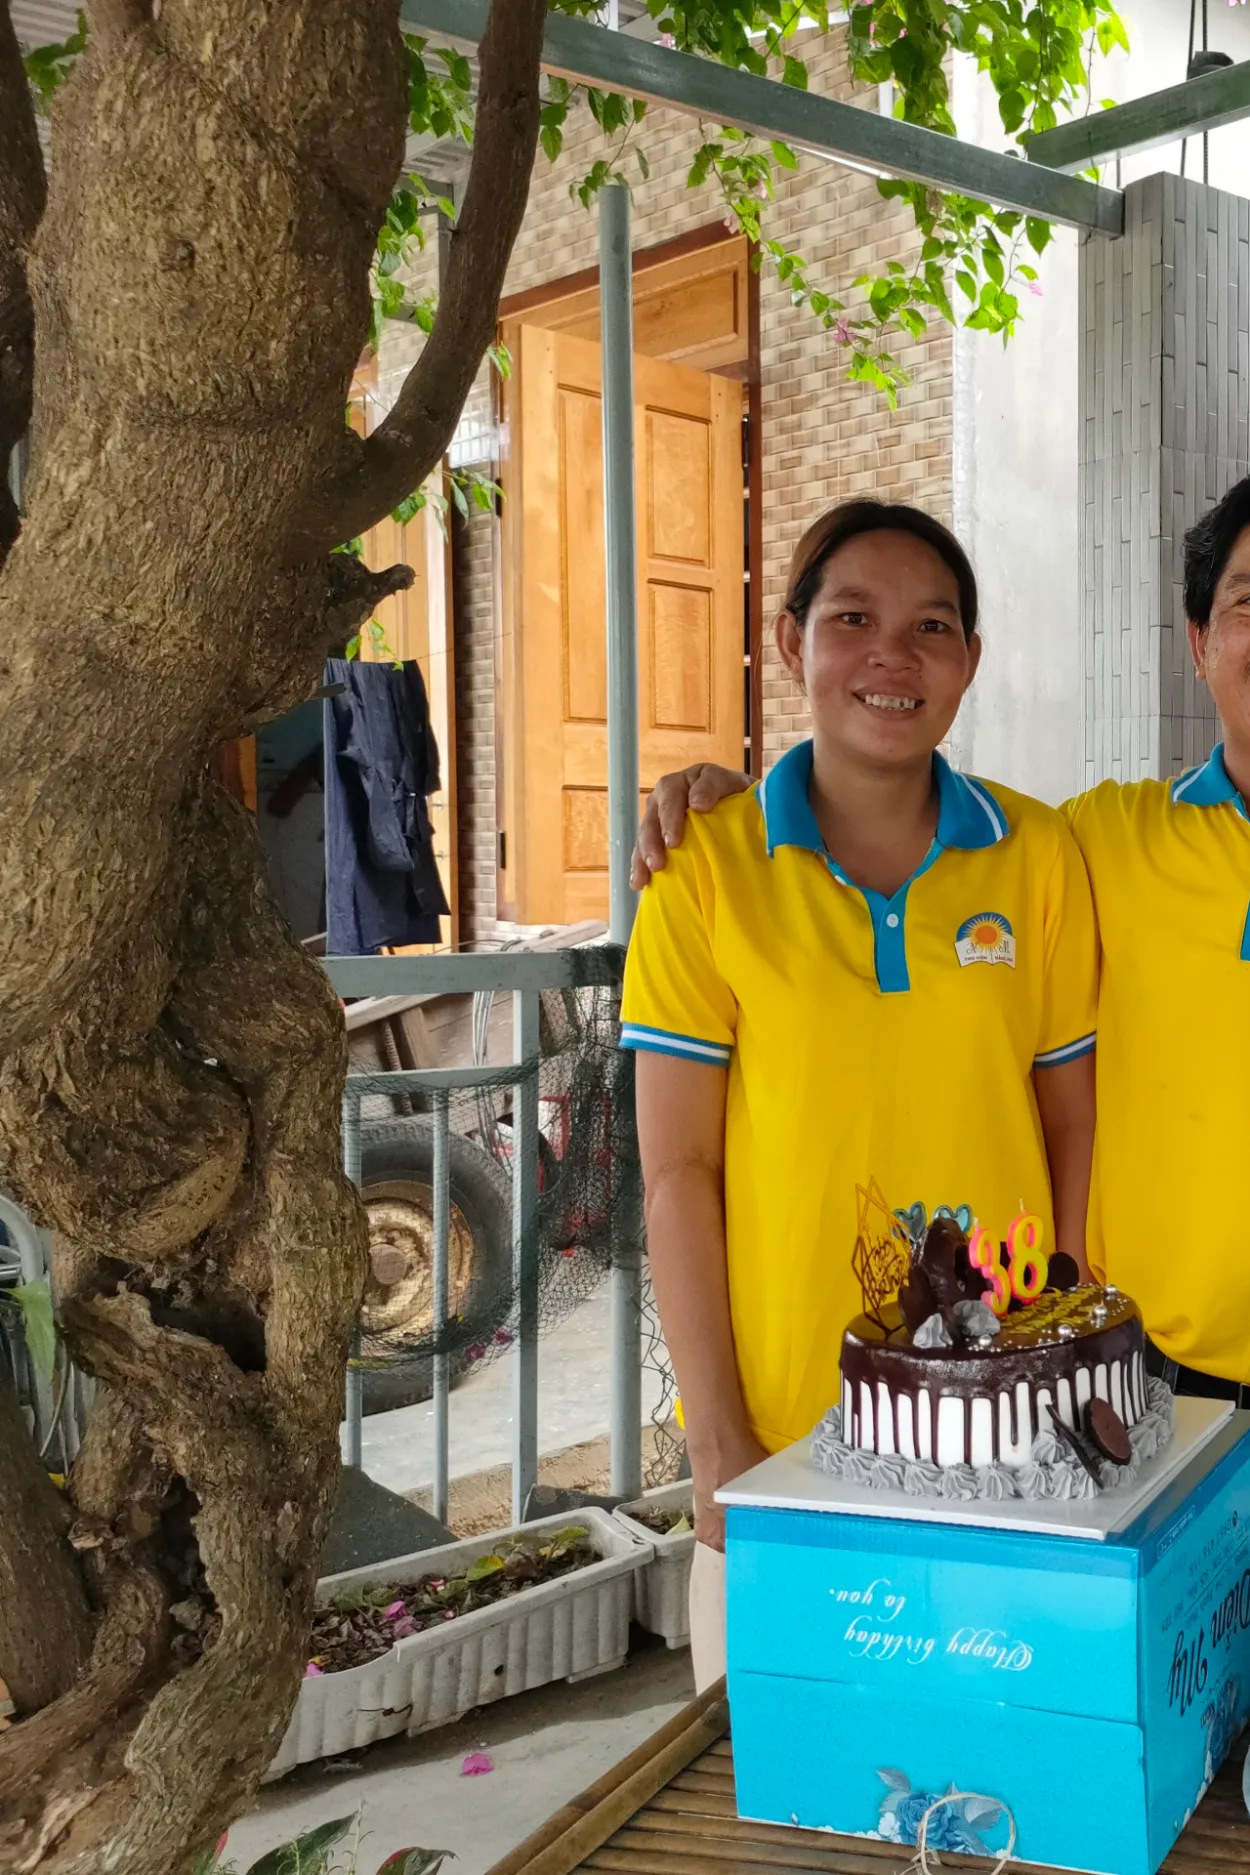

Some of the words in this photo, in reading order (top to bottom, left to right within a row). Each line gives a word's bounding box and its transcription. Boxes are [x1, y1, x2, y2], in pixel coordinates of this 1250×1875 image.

[829, 1578, 891, 1606] you.
[877, 1593, 906, 1622] to
[844, 1615, 936, 1665] birthday
[948, 1627, 1034, 1671] Happy
